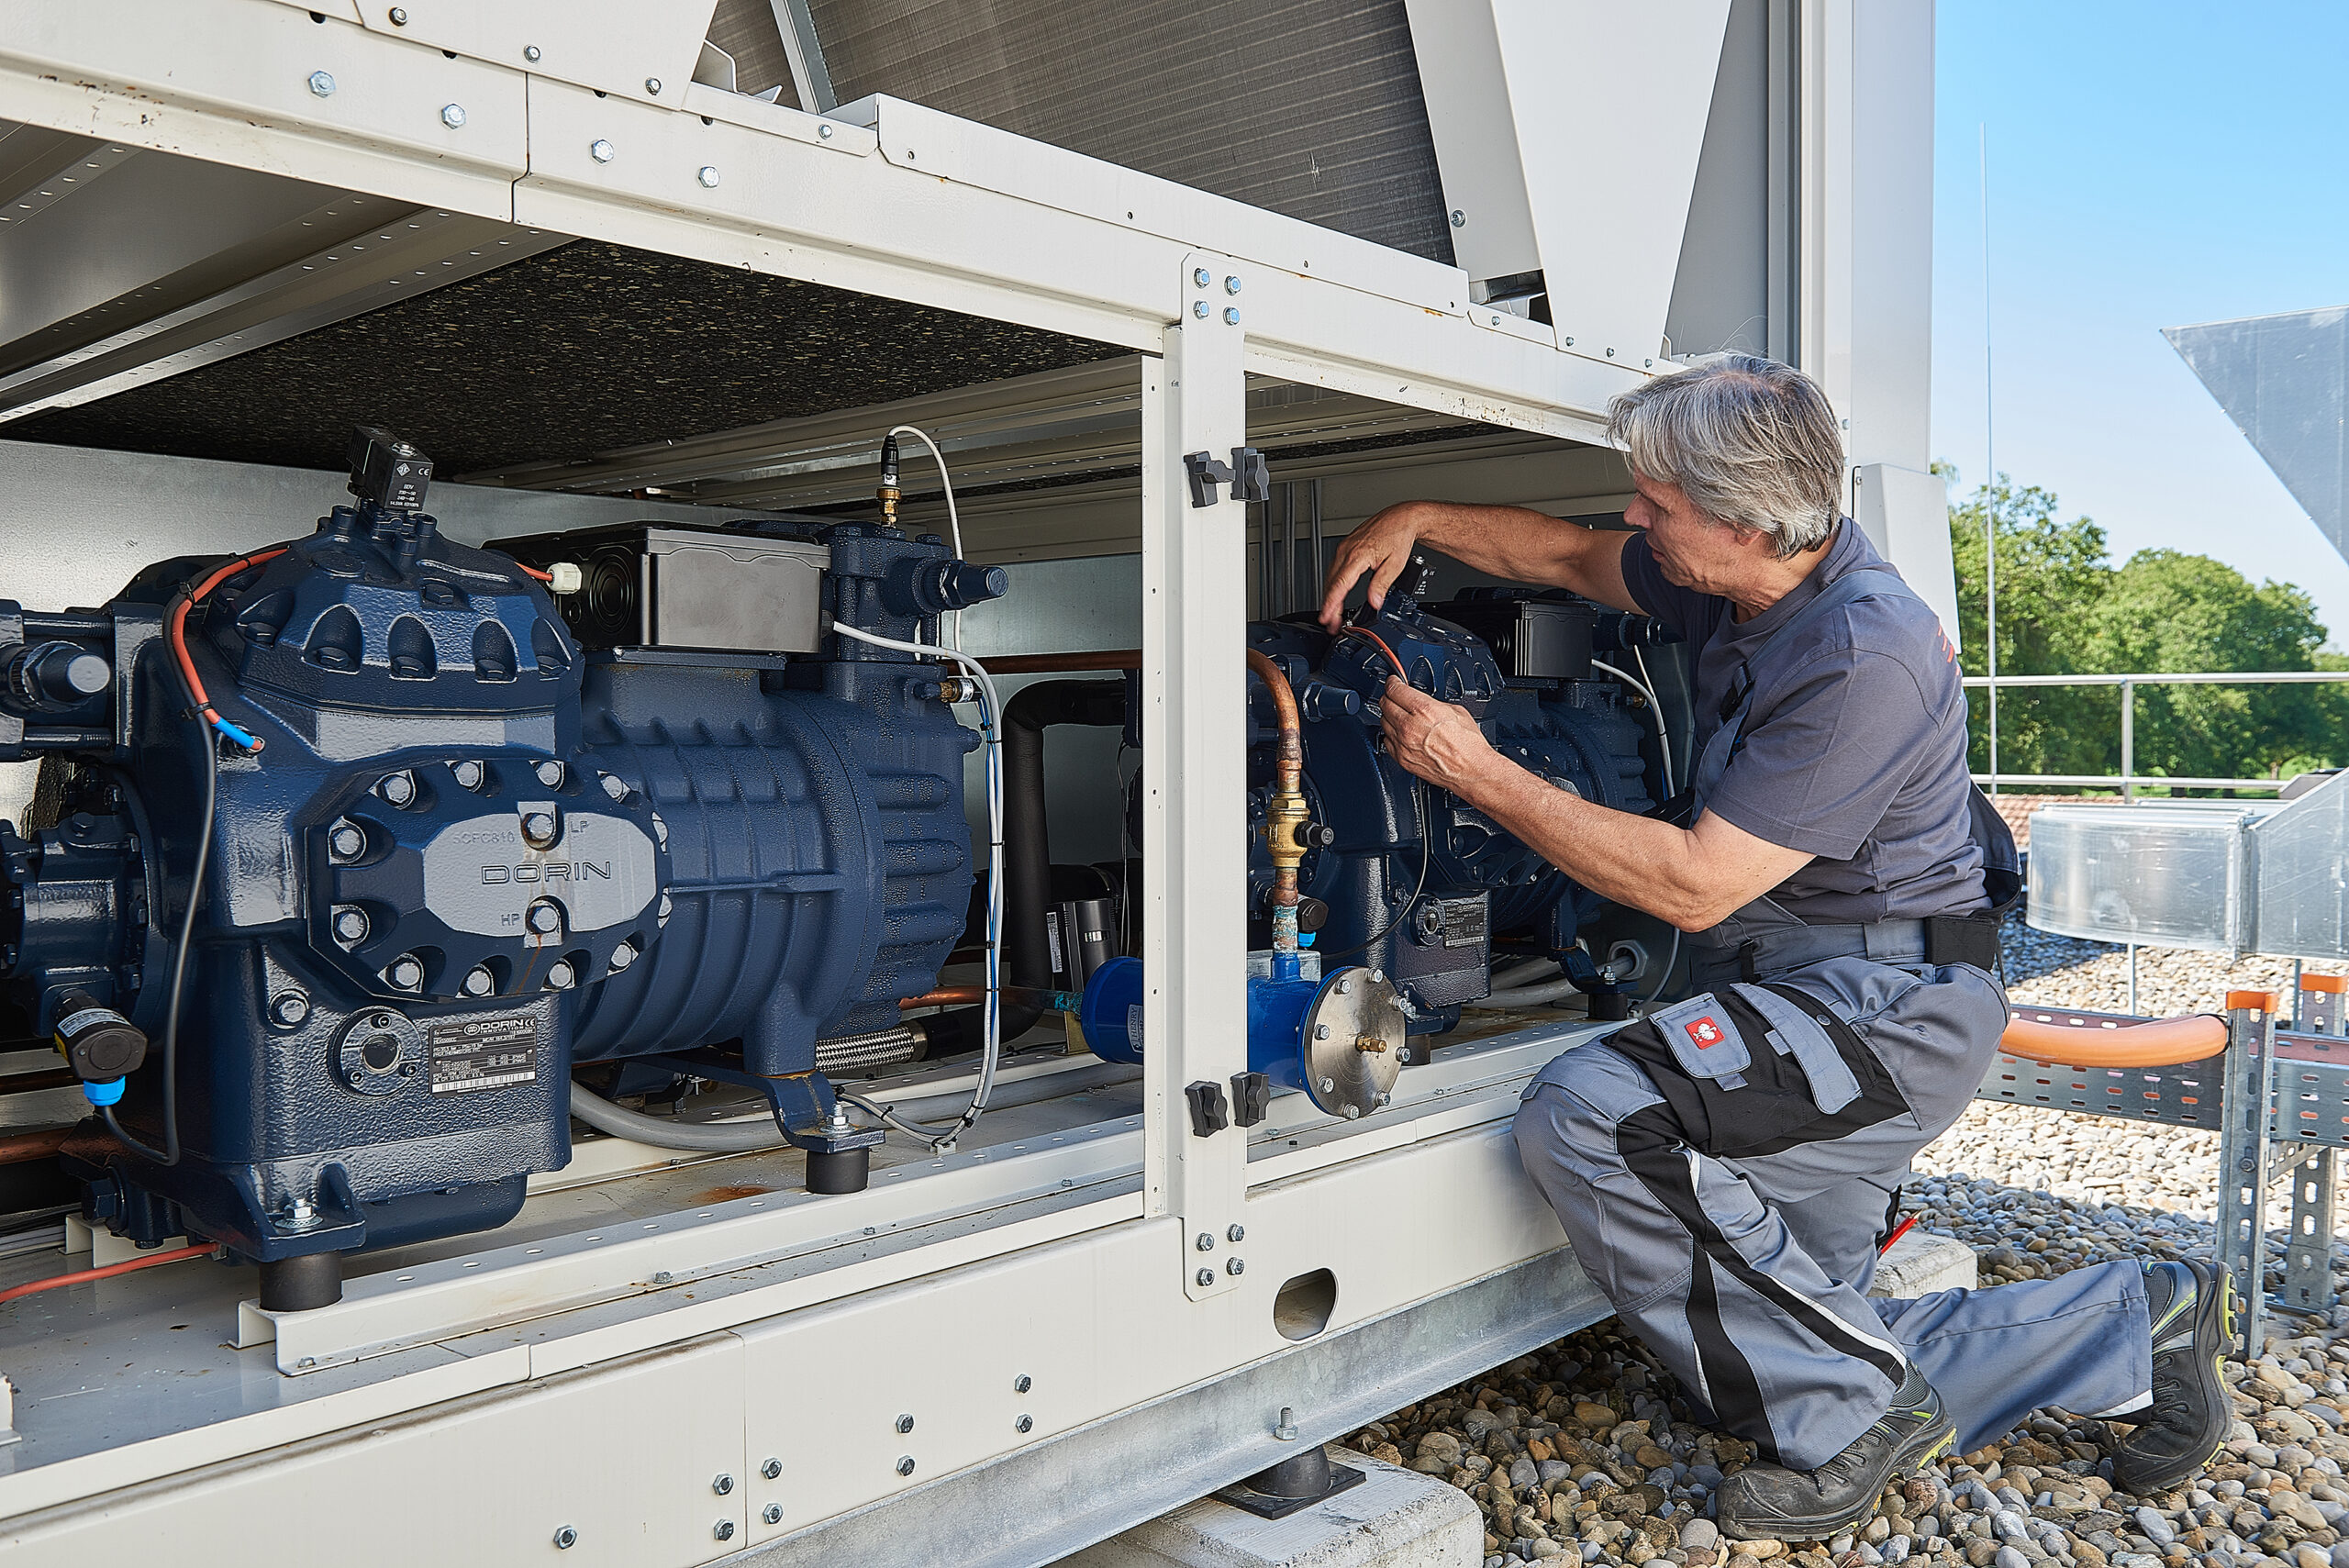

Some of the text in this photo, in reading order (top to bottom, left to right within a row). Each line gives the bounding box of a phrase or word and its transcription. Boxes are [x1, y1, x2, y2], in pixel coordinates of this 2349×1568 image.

[570, 820, 589, 833] LP
[481, 861, 611, 884] DORIN
[501, 913, 520, 926] HP
[480, 1018, 523, 1030] DORIN
[480, 1026, 524, 1034] INNOVATION
